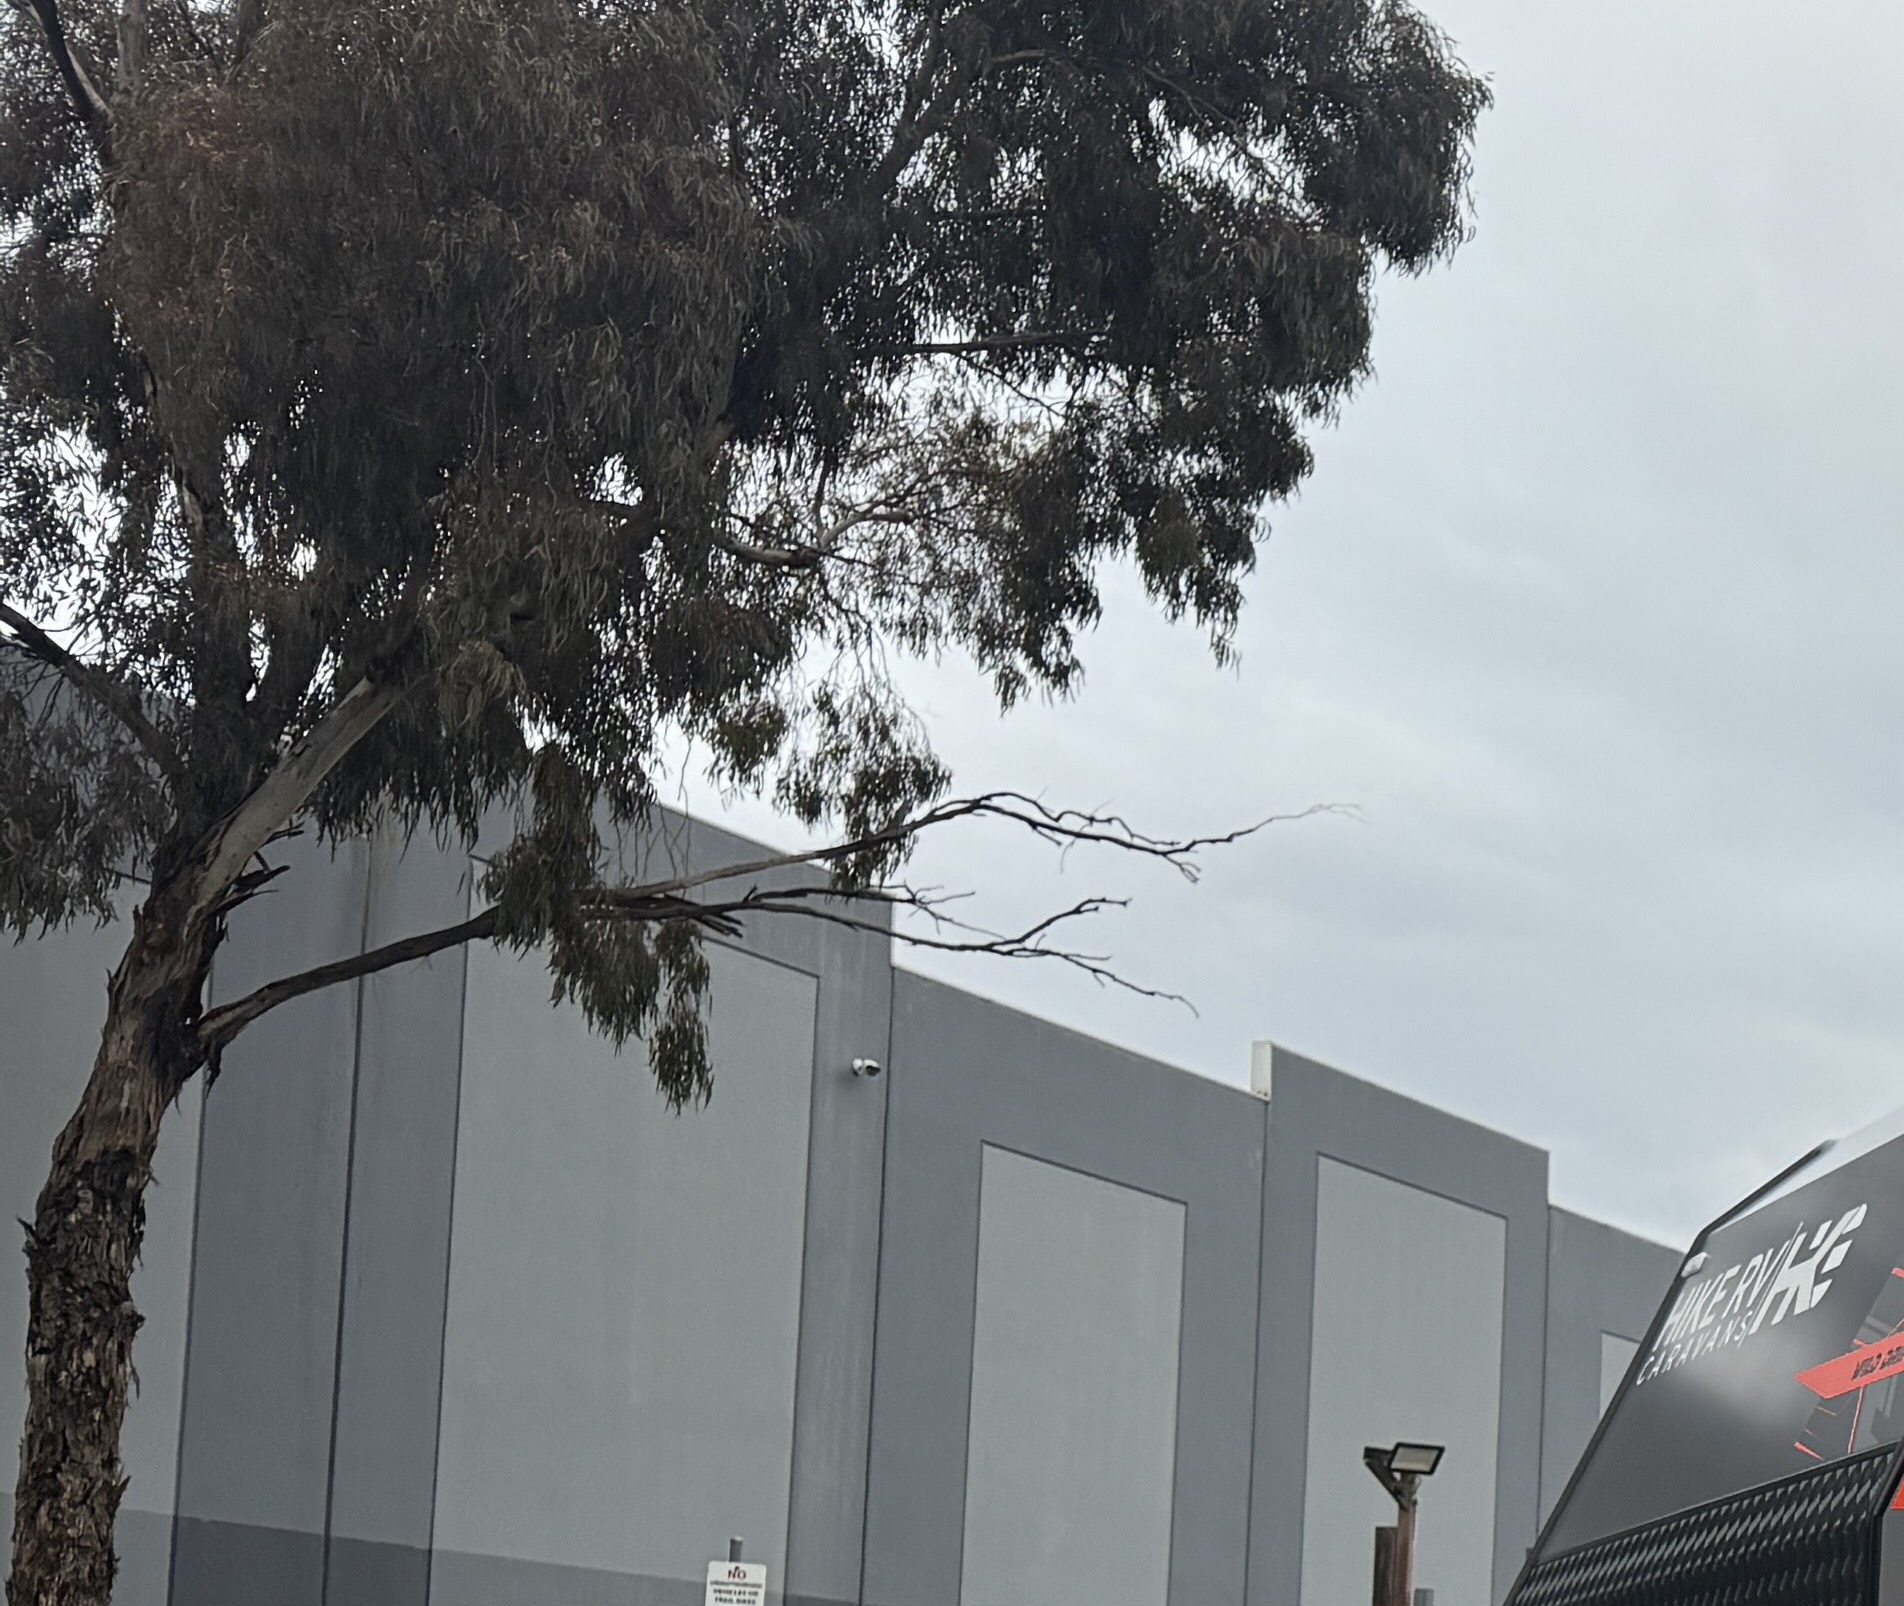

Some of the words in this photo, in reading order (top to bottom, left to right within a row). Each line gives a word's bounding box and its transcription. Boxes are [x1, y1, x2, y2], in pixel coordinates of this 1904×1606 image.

[1652, 1264, 1742, 1352] HIKE
[1721, 1239, 1791, 1320] RV
[1636, 1310, 1754, 1386] CARAVANS
[728, 1569, 747, 1580] NO
